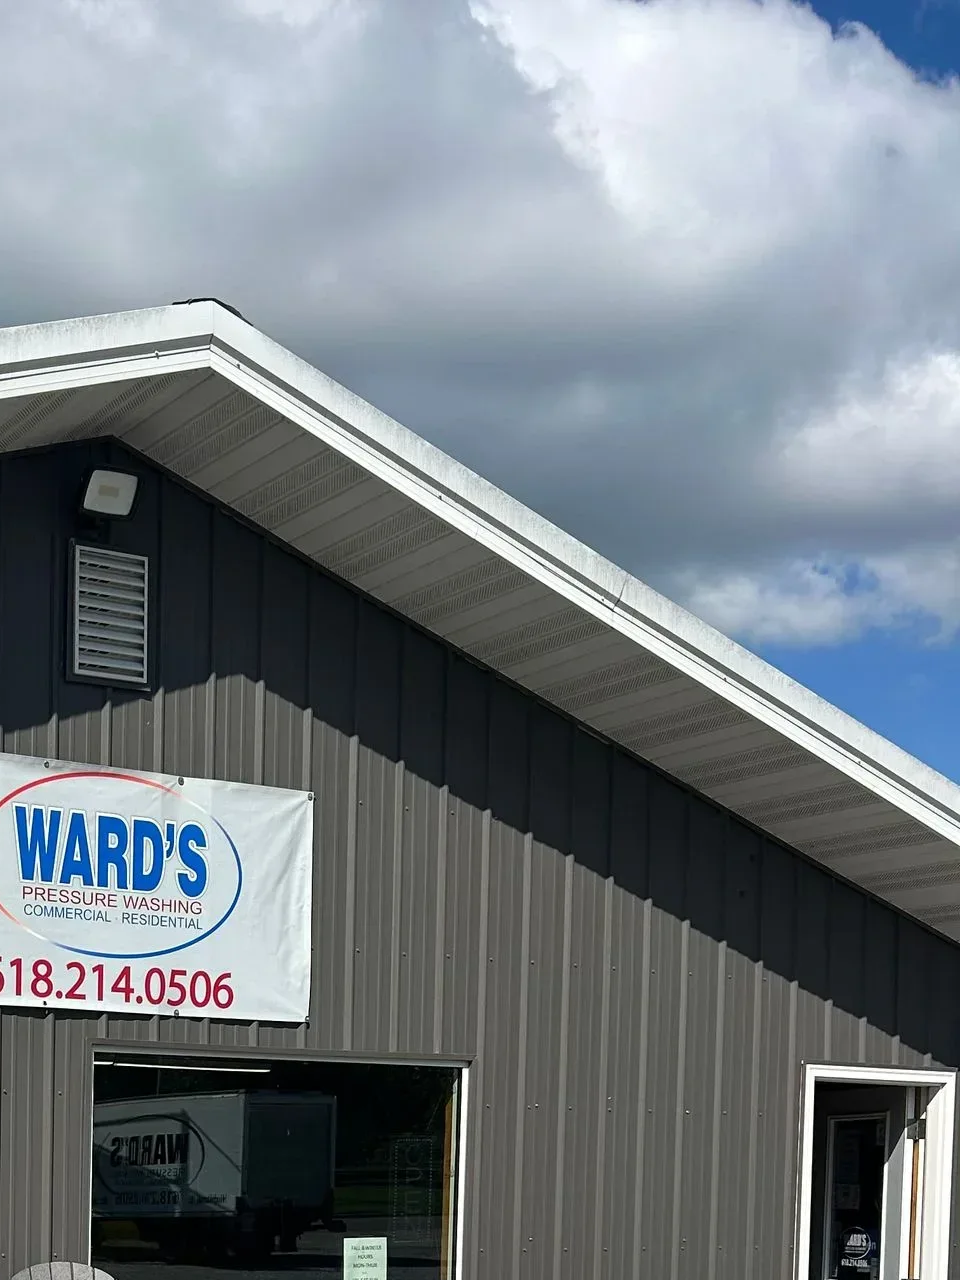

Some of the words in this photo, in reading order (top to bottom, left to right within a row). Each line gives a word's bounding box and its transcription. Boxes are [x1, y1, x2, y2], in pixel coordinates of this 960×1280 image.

[14, 804, 208, 897] WARD'S
[22, 886, 117, 908] PRESSURE
[123, 896, 203, 915] WASHING
[23, 904, 111, 923] COMMERCIAL
[121, 912, 203, 930] RESIDENTIAL
